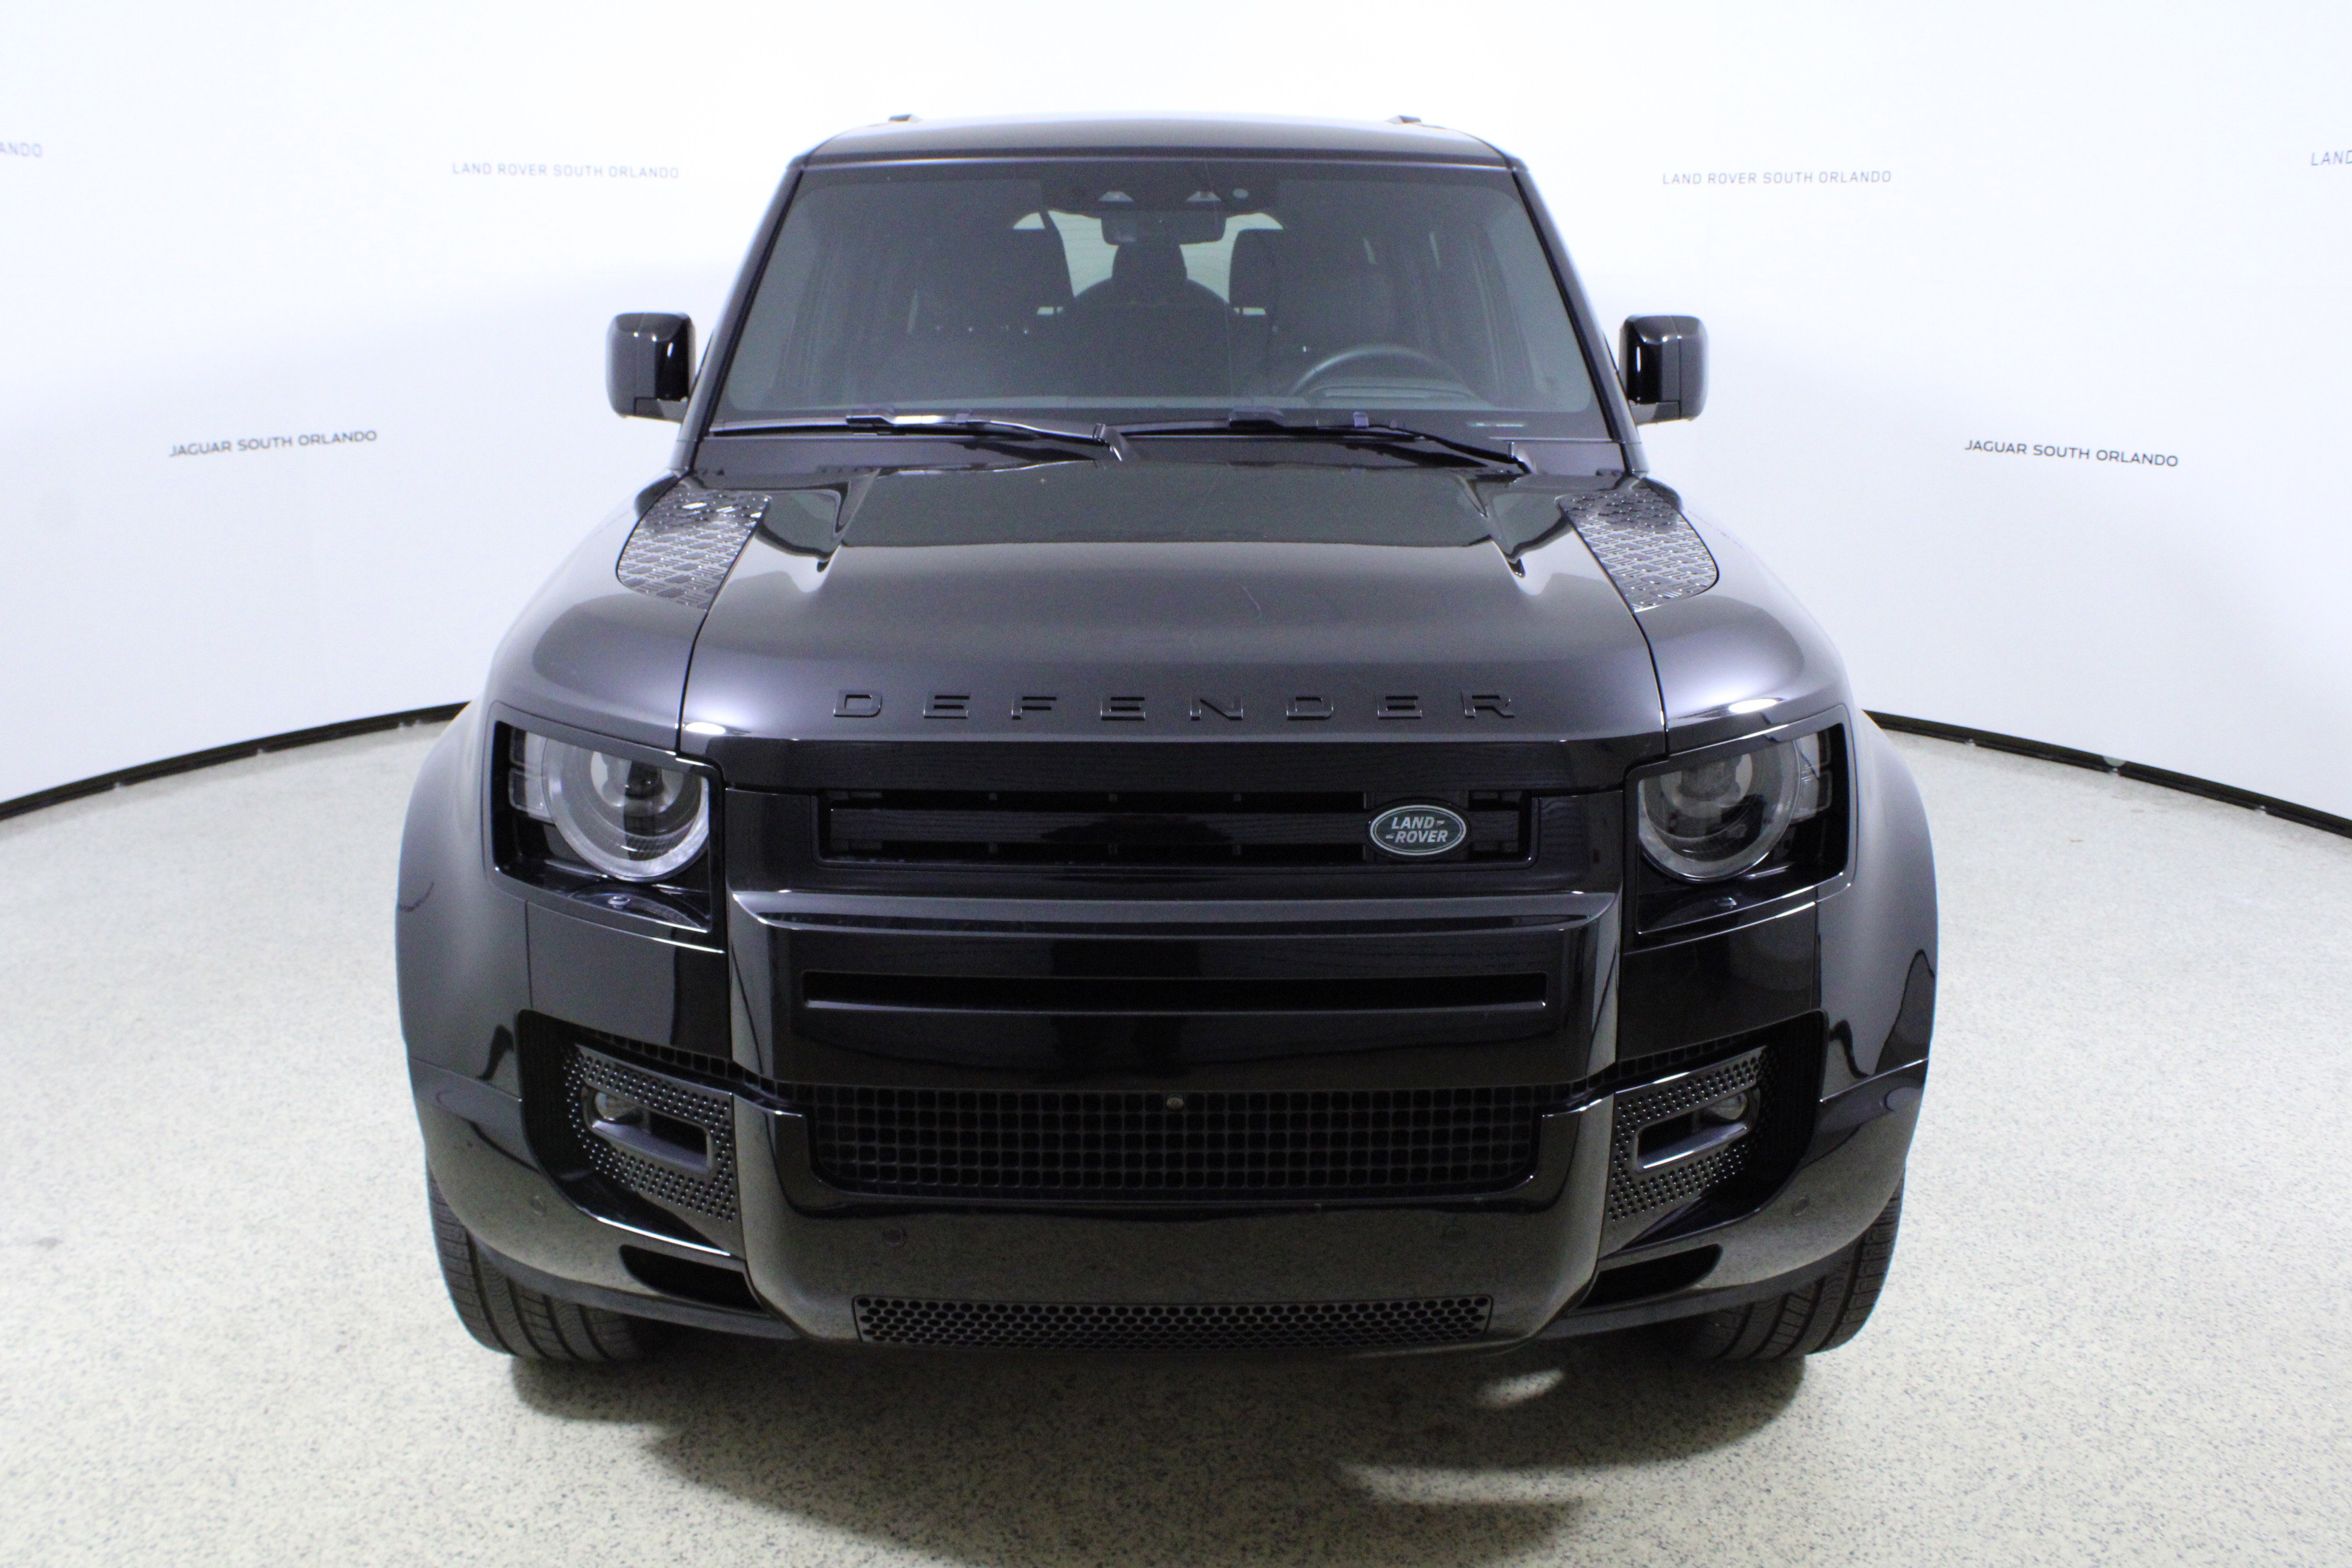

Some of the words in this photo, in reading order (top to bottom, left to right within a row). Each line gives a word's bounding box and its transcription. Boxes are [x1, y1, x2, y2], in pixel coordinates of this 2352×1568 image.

[452, 162, 492, 175] LAND
[498, 164, 547, 177] ROVER
[553, 164, 603, 177] SOUTH
[608, 165, 679, 178] ORLANDO
[1662, 173, 1701, 184] LAND
[1707, 172, 1757, 184] ROVER
[1763, 171, 1813, 184] SOUTH
[1819, 171, 1892, 184] ORLANDO
[169, 440, 233, 458] JAGUAR
[237, 436, 293, 452] SOUTH
[298, 430, 378, 447] ORLANDO
[1964, 439, 2027, 455] JAGUAR
[2033, 444, 2090, 460] SOUTH
[2096, 449, 2179, 468] ORLANDO
[832, 690, 1516, 720] DEFENDER
[1391, 816, 1435, 829] LAND
[1394, 829, 1449, 844] ROVER
